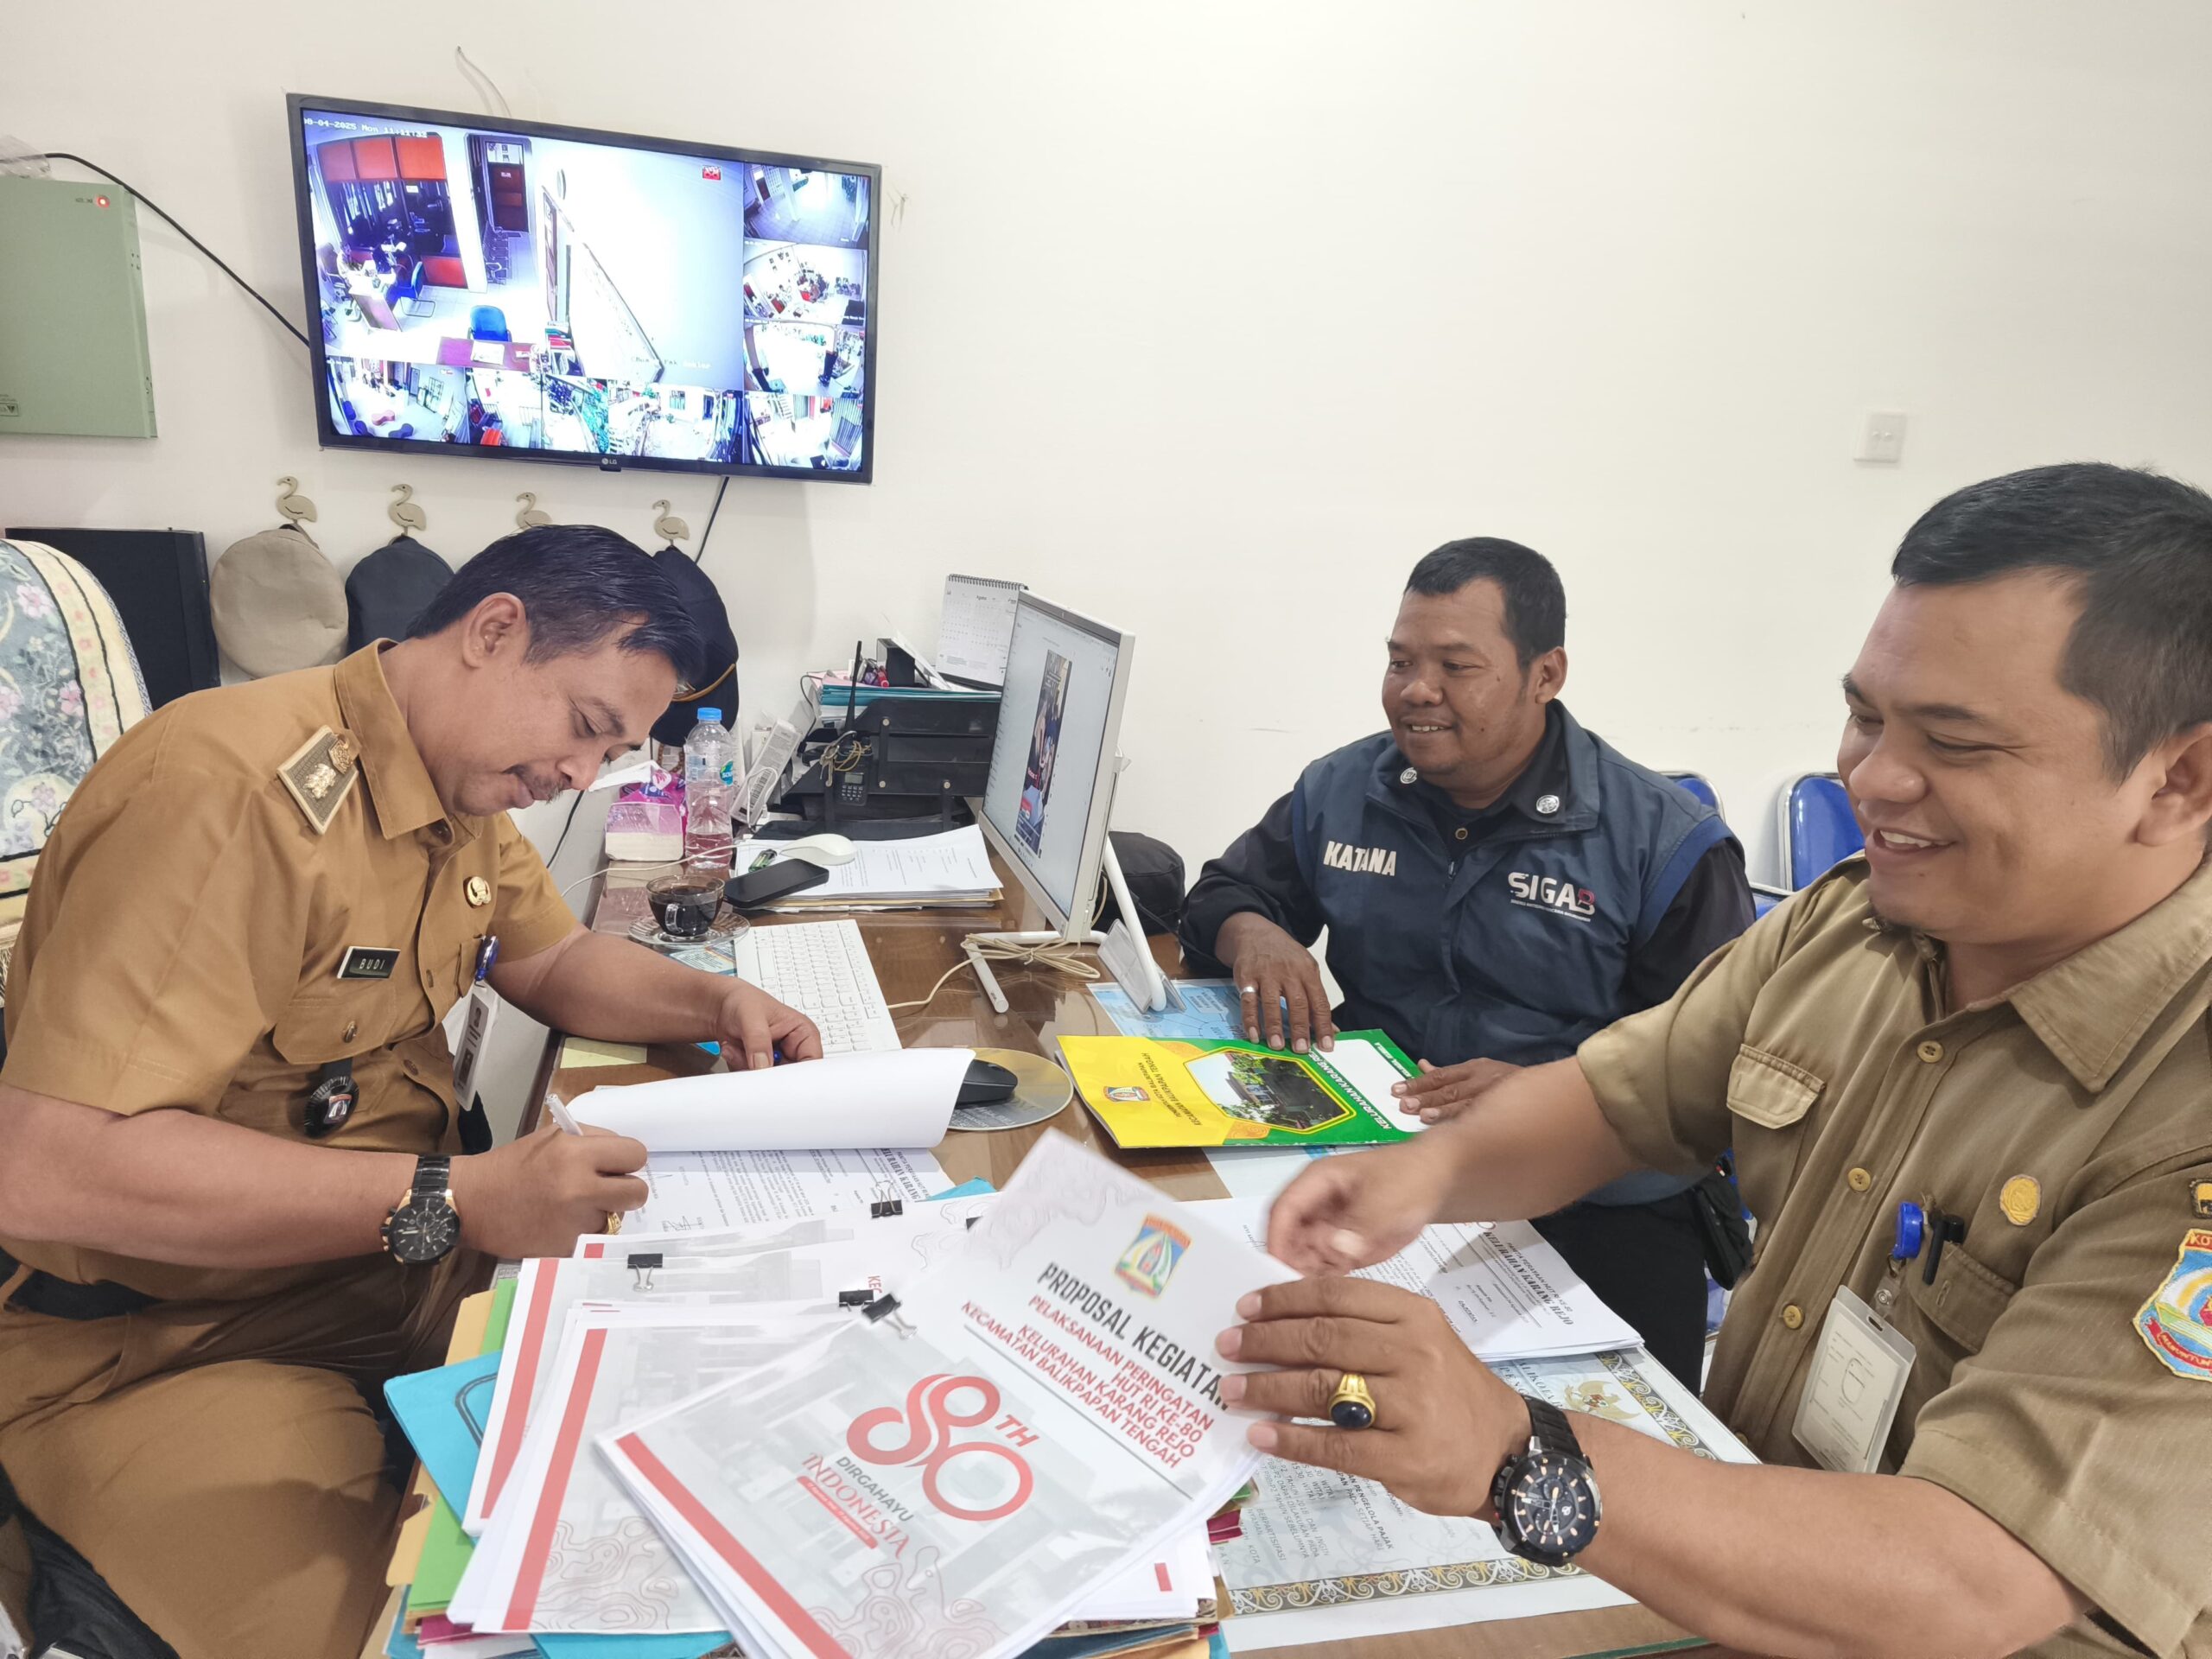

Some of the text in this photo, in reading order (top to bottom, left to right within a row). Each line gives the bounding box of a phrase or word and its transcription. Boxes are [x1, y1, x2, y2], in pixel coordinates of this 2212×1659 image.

[361, 124, 378, 133] Mon
[1323, 840, 1397, 876] KATANA
[359, 958, 385, 969] BUDI
[1141, 1052, 1159, 1072] TENGAH
[1318, 1058, 1348, 1088] KARANG
[1344, 1086, 1392, 1129] KELURAHAN
[1038, 1261, 1132, 1340] PROPOSAL
[1483, 1231, 1527, 1275] KELURAHAN
[1522, 1272, 1553, 1305] KARANG
[1549, 1301, 1573, 1325] REJO
[961, 1300, 1181, 1469] KECAMATAN BALIKPAPAN TENGAH
[1018, 1324, 1195, 1459] KELURAHAN KARANG REJO
[1028, 1294, 1215, 1431] PELAKSANAAN PERINGATAN
[995, 1414, 1039, 1447] TH
[1111, 1373, 1203, 1444] HUT RI KE-80
[801, 1452, 910, 1560] INDONESIA
[836, 1456, 914, 1522] DIRGAHAYU
[1277, 1479, 1292, 1499] DAPAT
[1287, 1501, 1310, 1538] DILAKUKAN
[1307, 1539, 1319, 1557] PADA
[1286, 1475, 1299, 1496] TAHUN
[1306, 1518, 1318, 1533] DAN
[1347, 1488, 1359, 1506] PADA
[1356, 1508, 1375, 1532] SETIAP
[1370, 1534, 1384, 1551] HARI
[1353, 1484, 1380, 1525] PENGELOLA
[1377, 1526, 1394, 1549] PAJAK
[1249, 1545, 1261, 1564] KOTA
[1274, 1493, 1288, 1514] TAHUN
[1284, 1516, 1310, 1559] SEBELUMNYA
